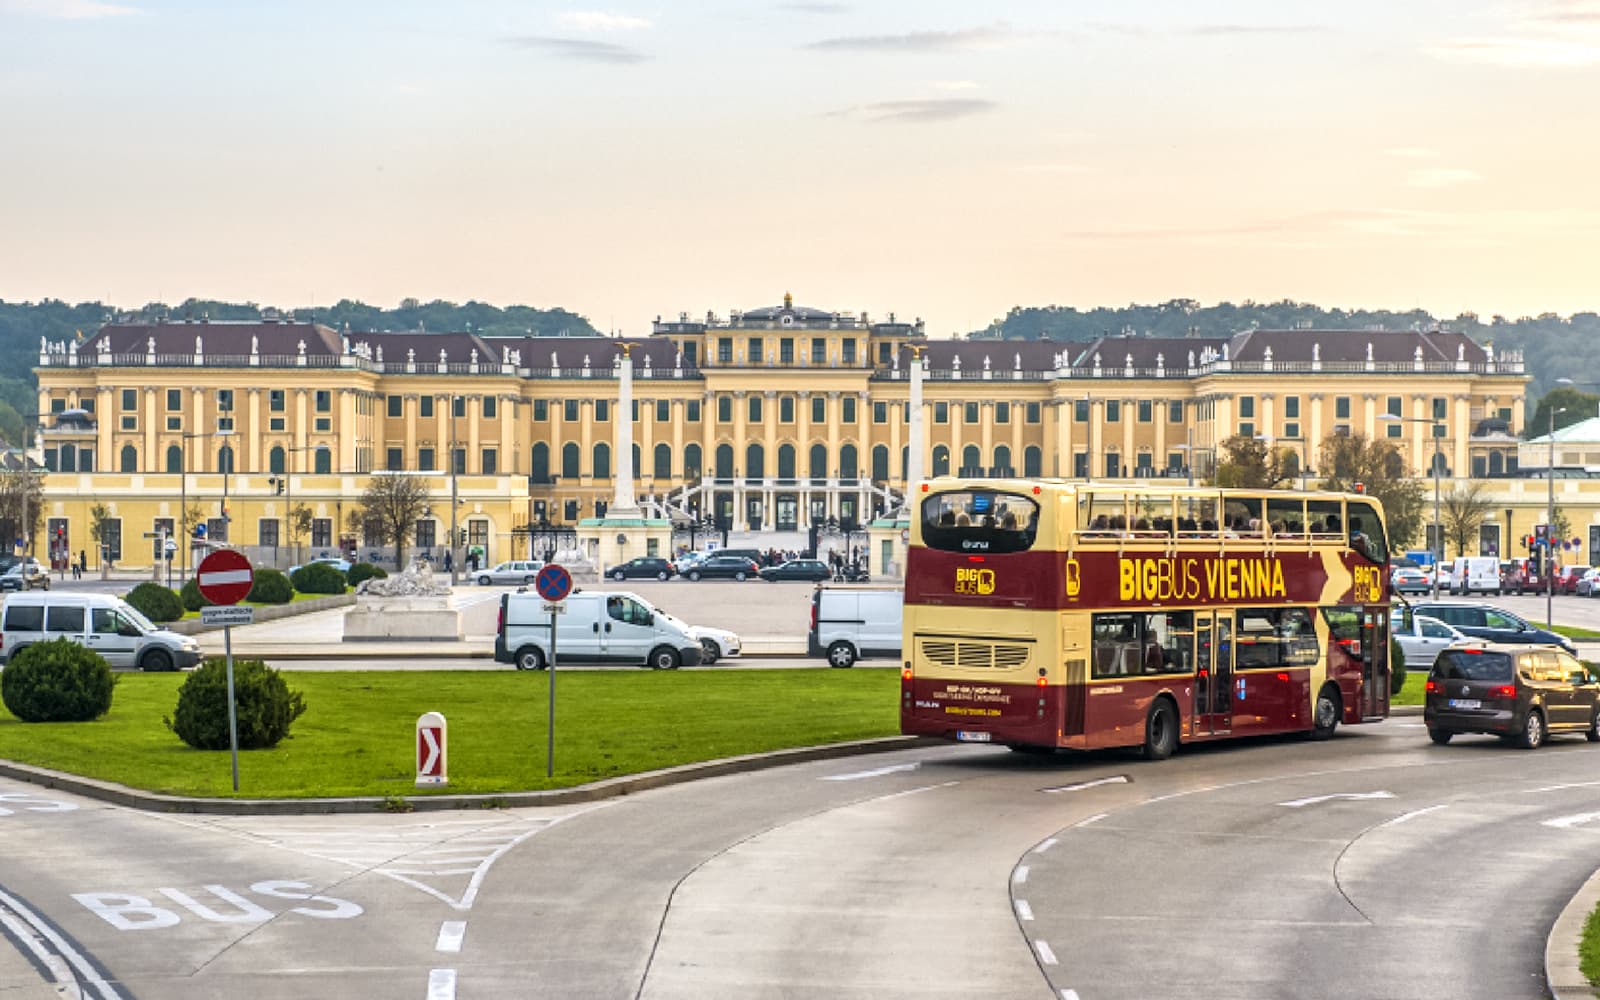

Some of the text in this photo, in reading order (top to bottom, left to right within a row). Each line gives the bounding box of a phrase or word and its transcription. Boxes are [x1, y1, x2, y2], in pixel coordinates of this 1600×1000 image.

[956, 568, 977, 582] BIG
[1204, 558, 1287, 599] VIENNA
[1354, 565, 1370, 584] BIG
[71, 879, 365, 931] BUS
